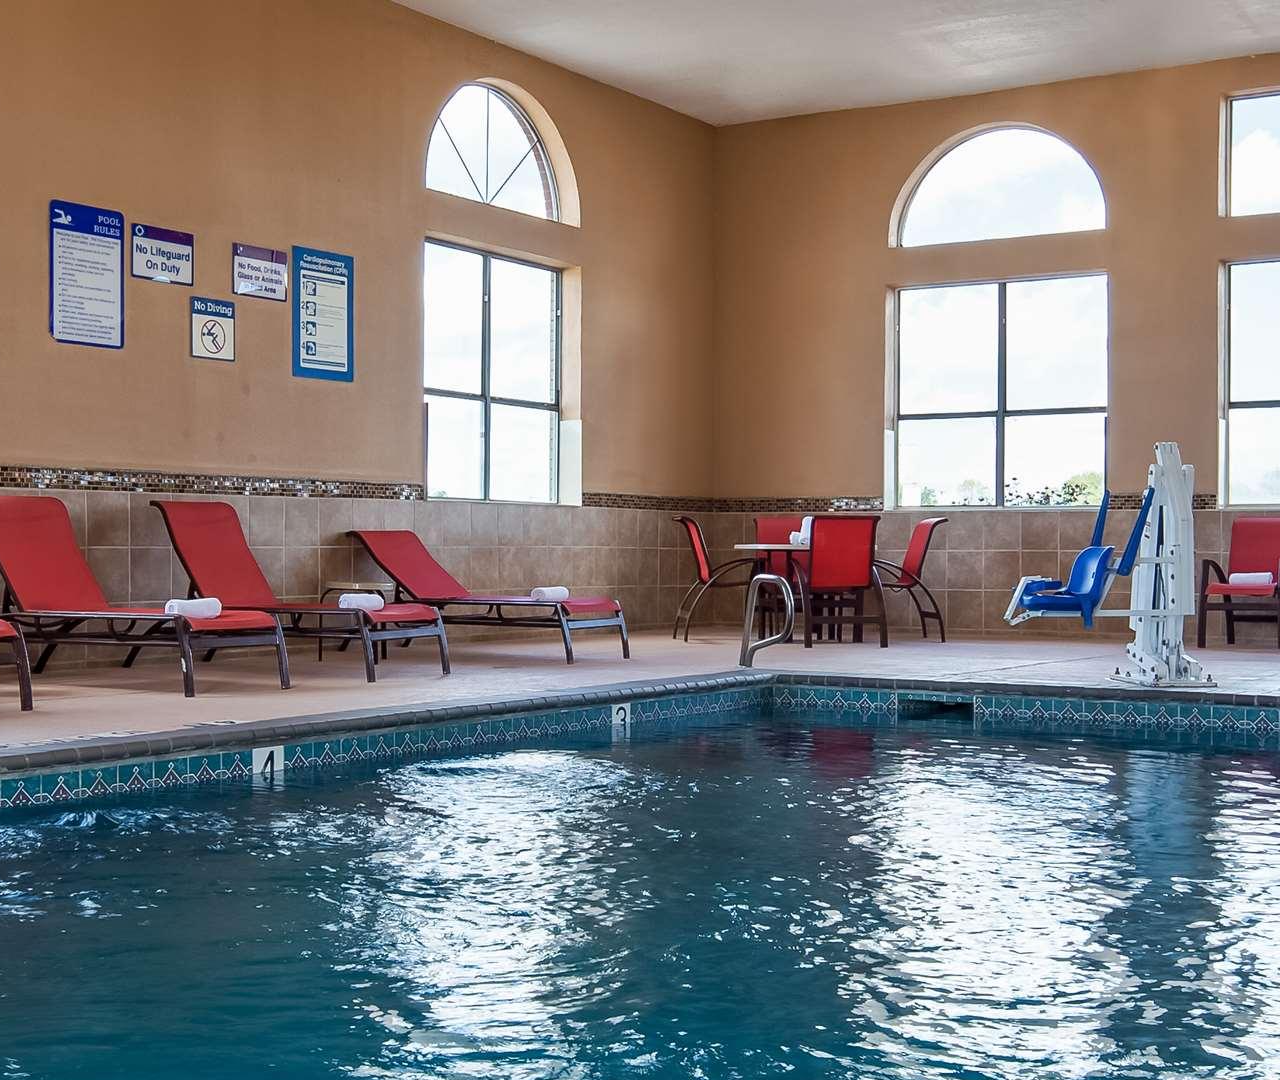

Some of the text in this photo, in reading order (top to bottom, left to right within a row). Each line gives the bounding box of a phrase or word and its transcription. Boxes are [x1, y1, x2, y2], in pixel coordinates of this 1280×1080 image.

[98, 215, 121, 227] POOL
[93, 225, 121, 237] RULES
[135, 243, 191, 262] No Lifeguard
[145, 259, 181, 276] On Duty
[238, 262, 246, 270] No
[247, 263, 262, 273] Food,
[237, 271, 253, 281] Glass
[262, 275, 283, 286] Animals
[263, 285, 276, 294] Area
[193, 301, 233, 316] No Diving
